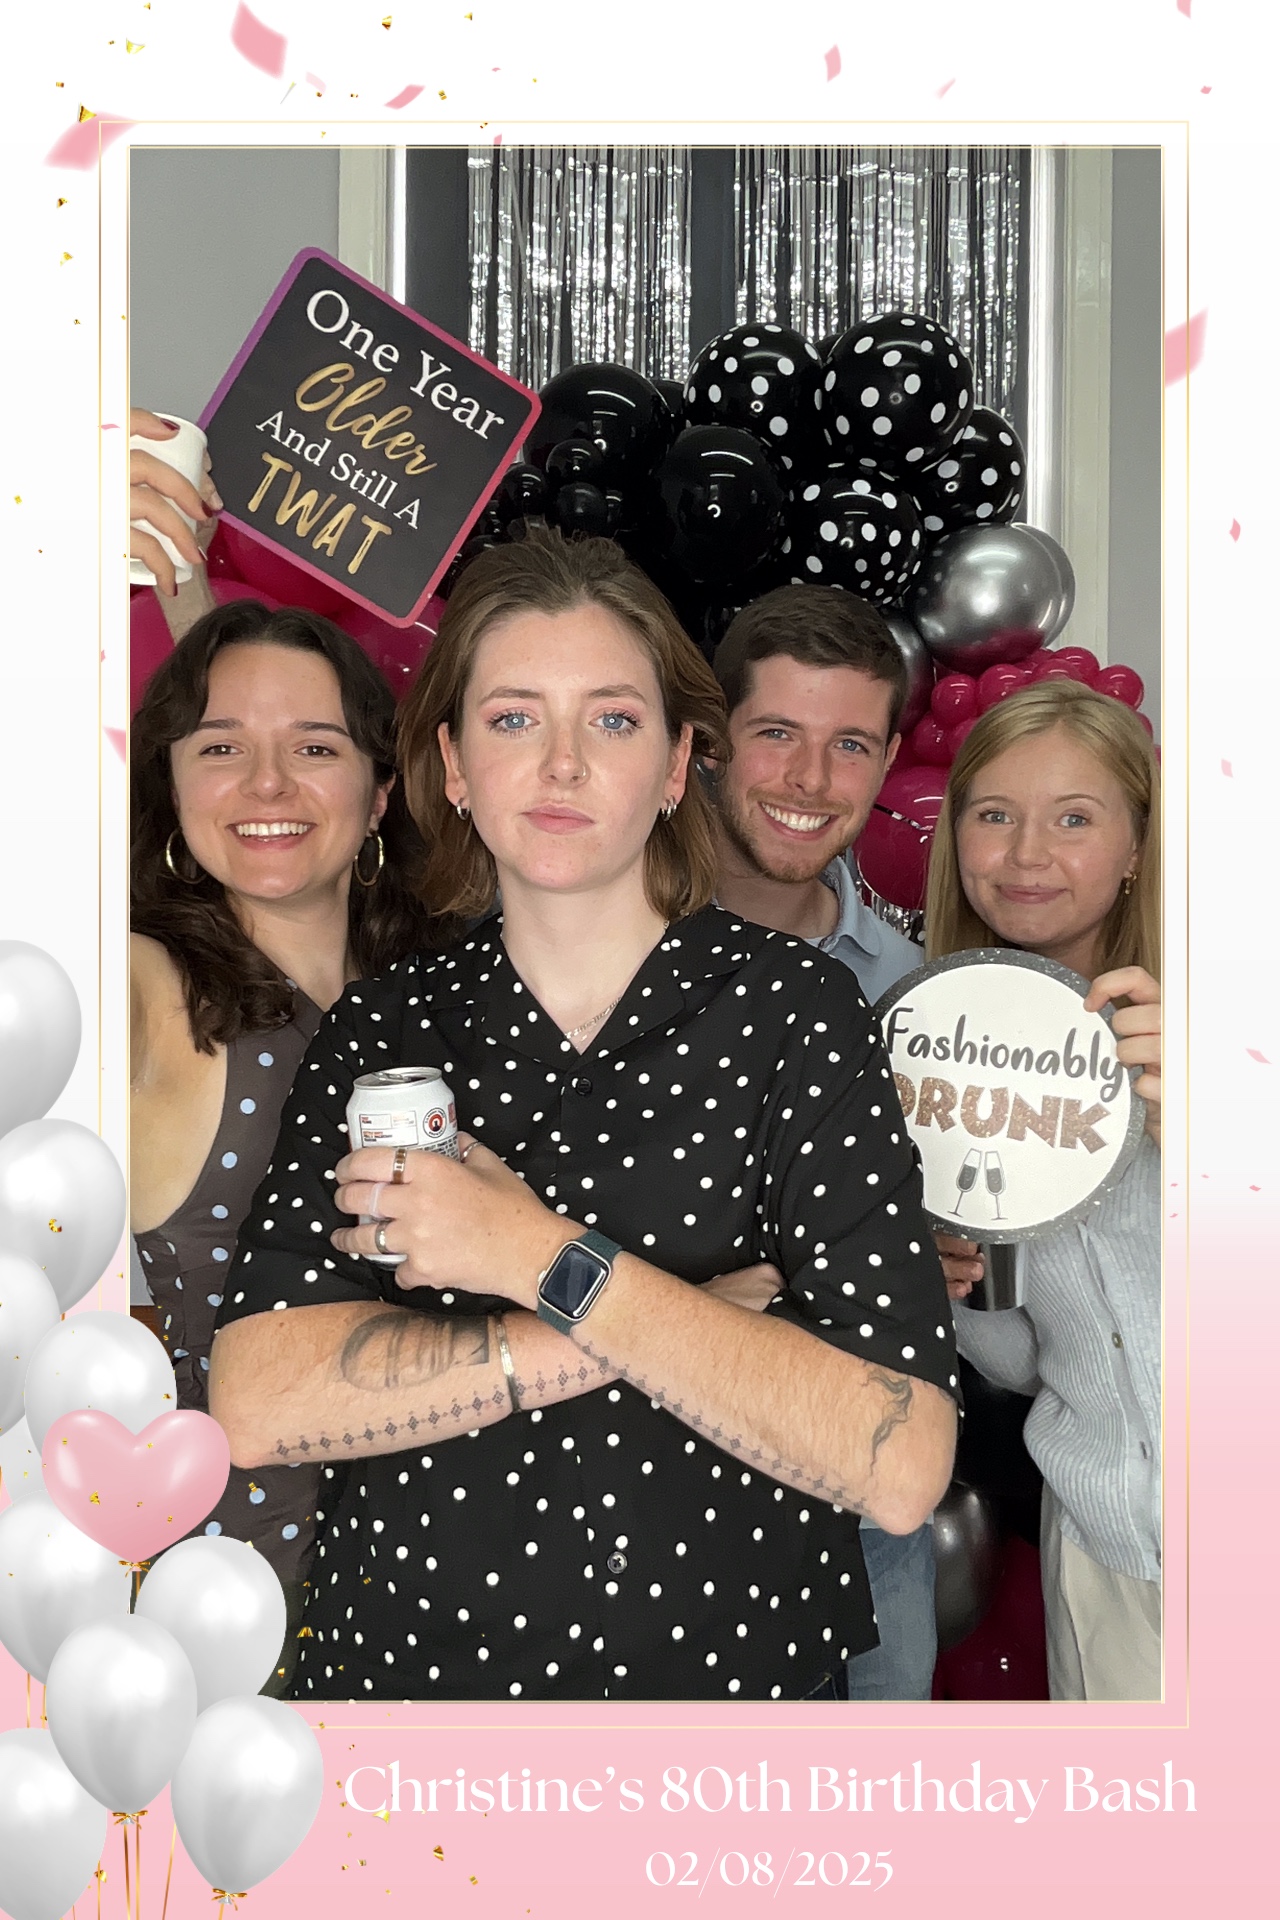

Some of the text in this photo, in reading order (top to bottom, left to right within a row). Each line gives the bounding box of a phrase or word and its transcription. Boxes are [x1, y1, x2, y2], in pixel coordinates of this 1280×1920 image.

[295, 362, 437, 476] Older
[306, 289, 505, 440] One Year
[247, 452, 393, 575] TWAT
[255, 410, 421, 530] And Still A
[887, 1006, 1124, 1103] Fashionably
